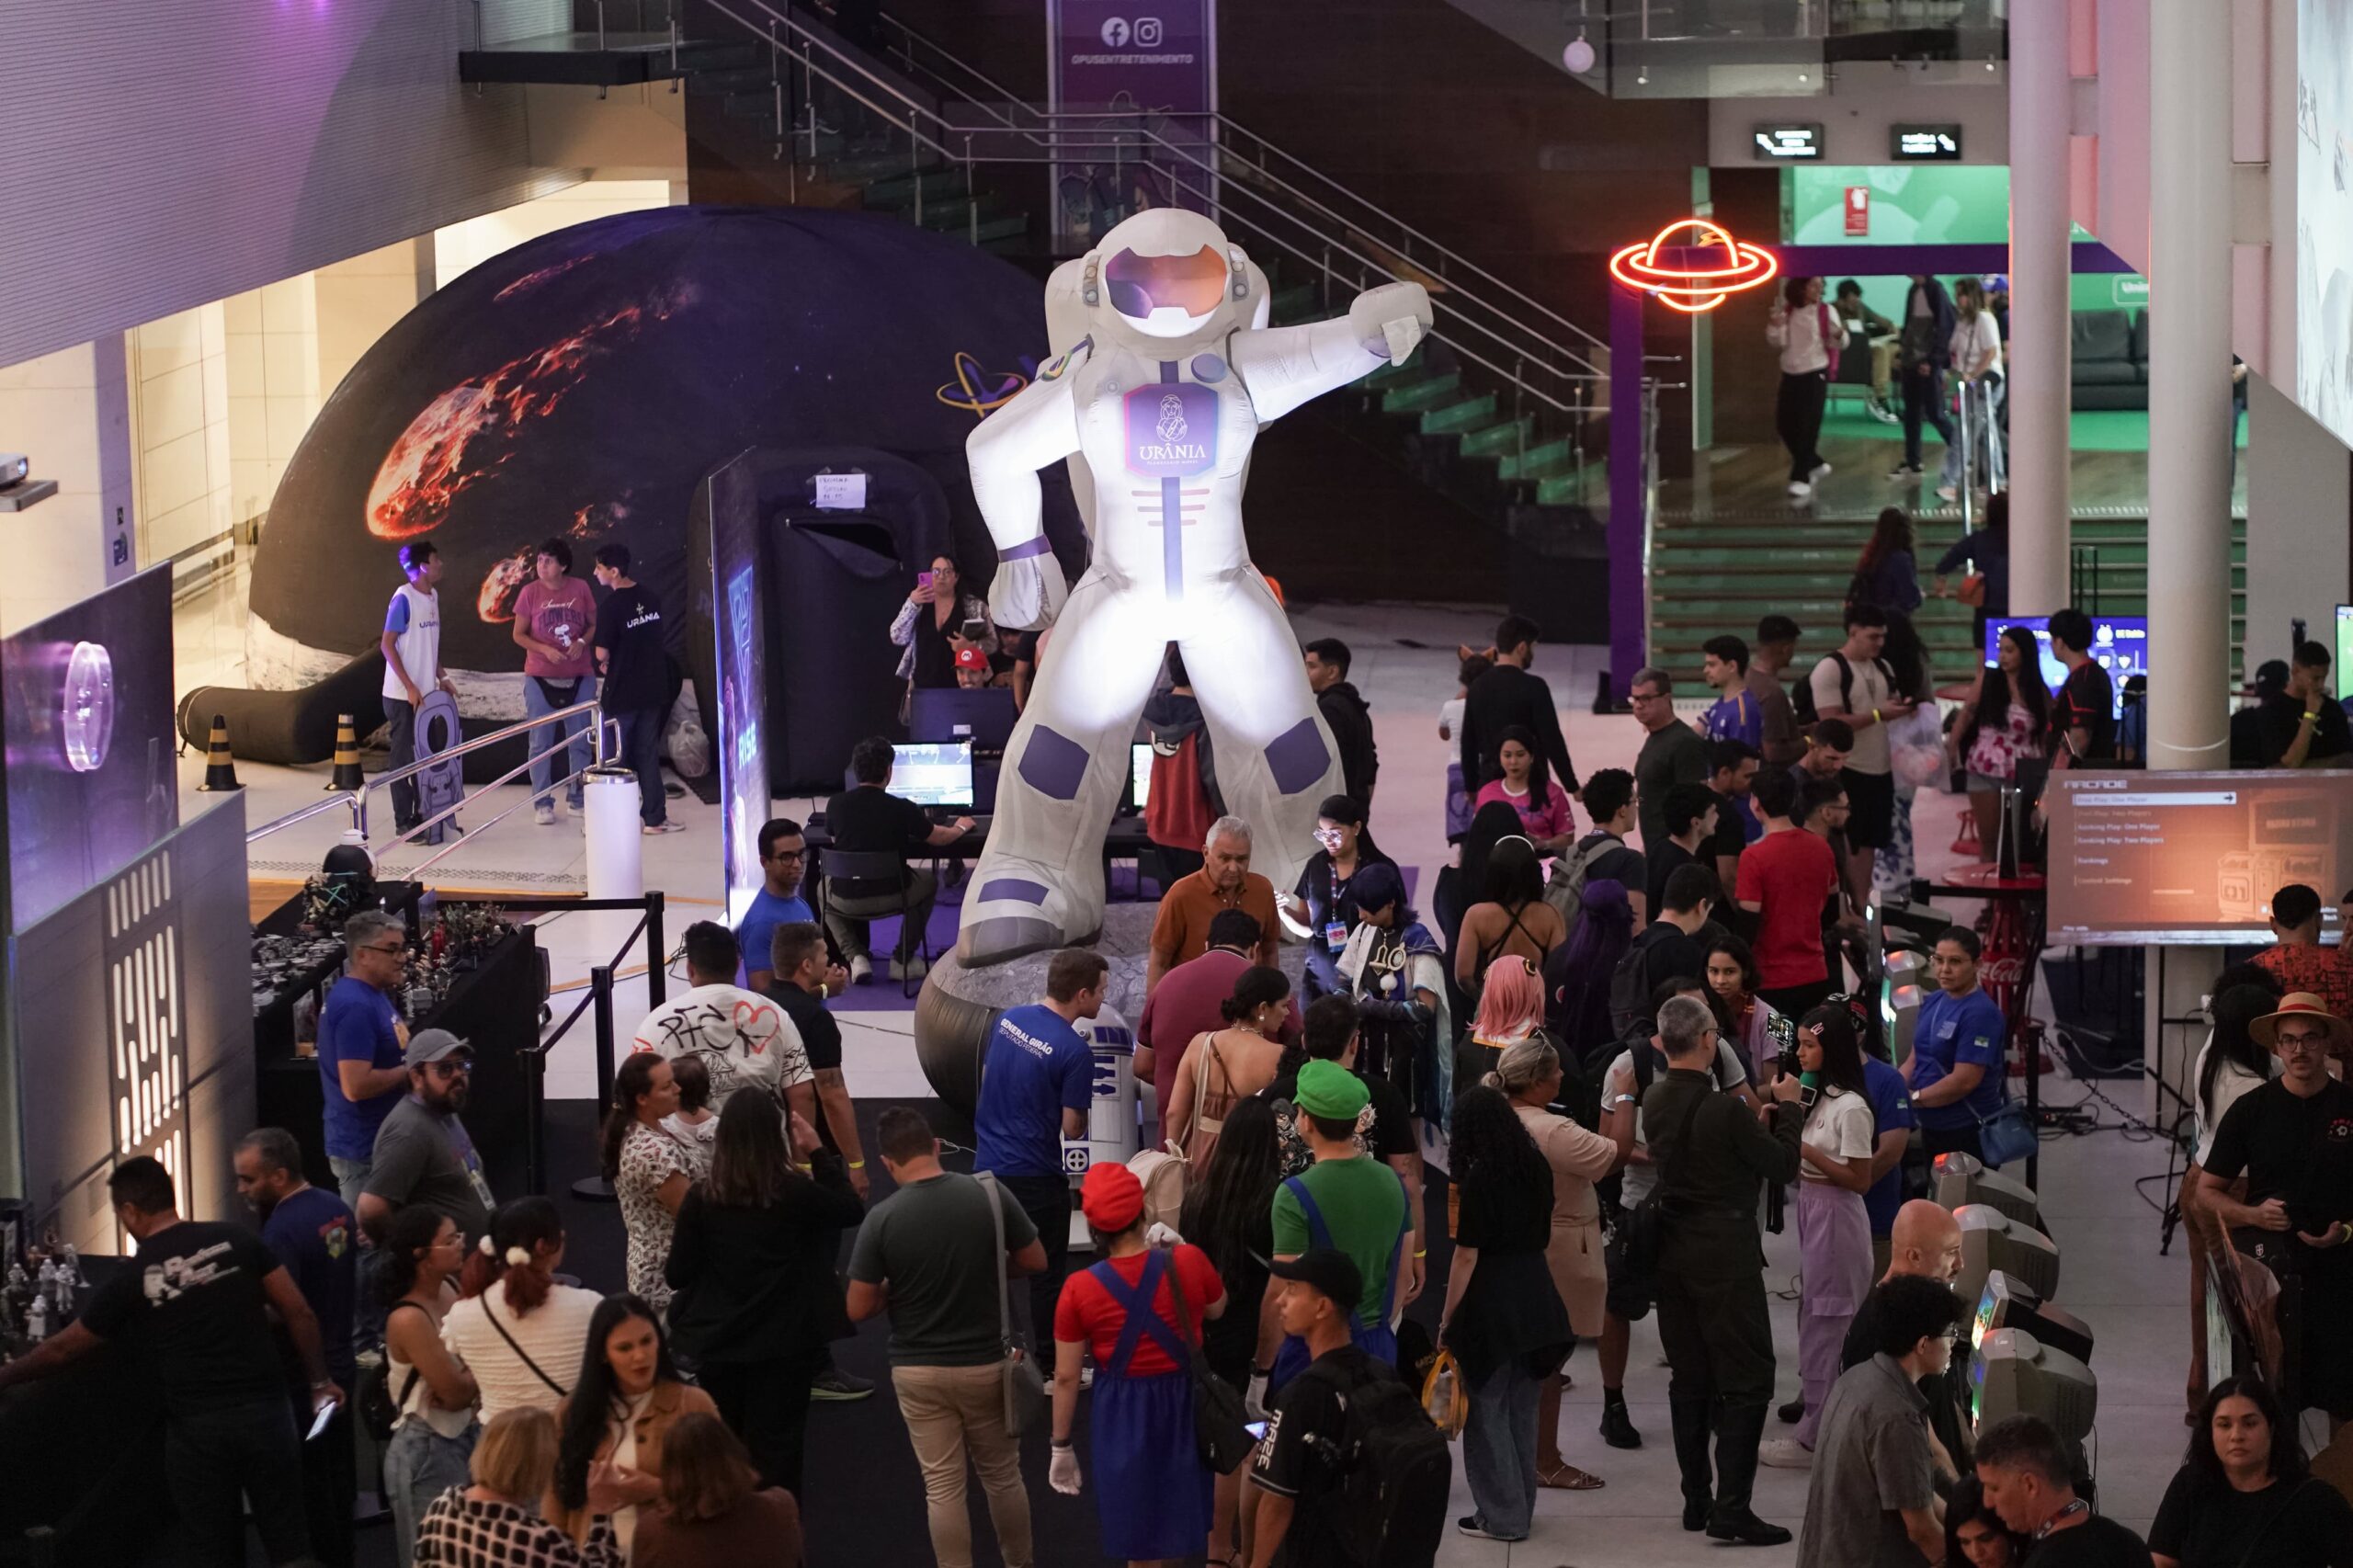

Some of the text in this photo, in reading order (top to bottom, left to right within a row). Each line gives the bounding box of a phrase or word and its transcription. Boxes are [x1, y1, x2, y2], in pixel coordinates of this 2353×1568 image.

[1140, 442, 1206, 460] URÂNIA
[738, 721, 757, 771] RISE
[998, 1027, 1044, 1060] DEPUTADO FEDERAL
[1000, 1017, 1054, 1056] GENERAL GIRÃO
